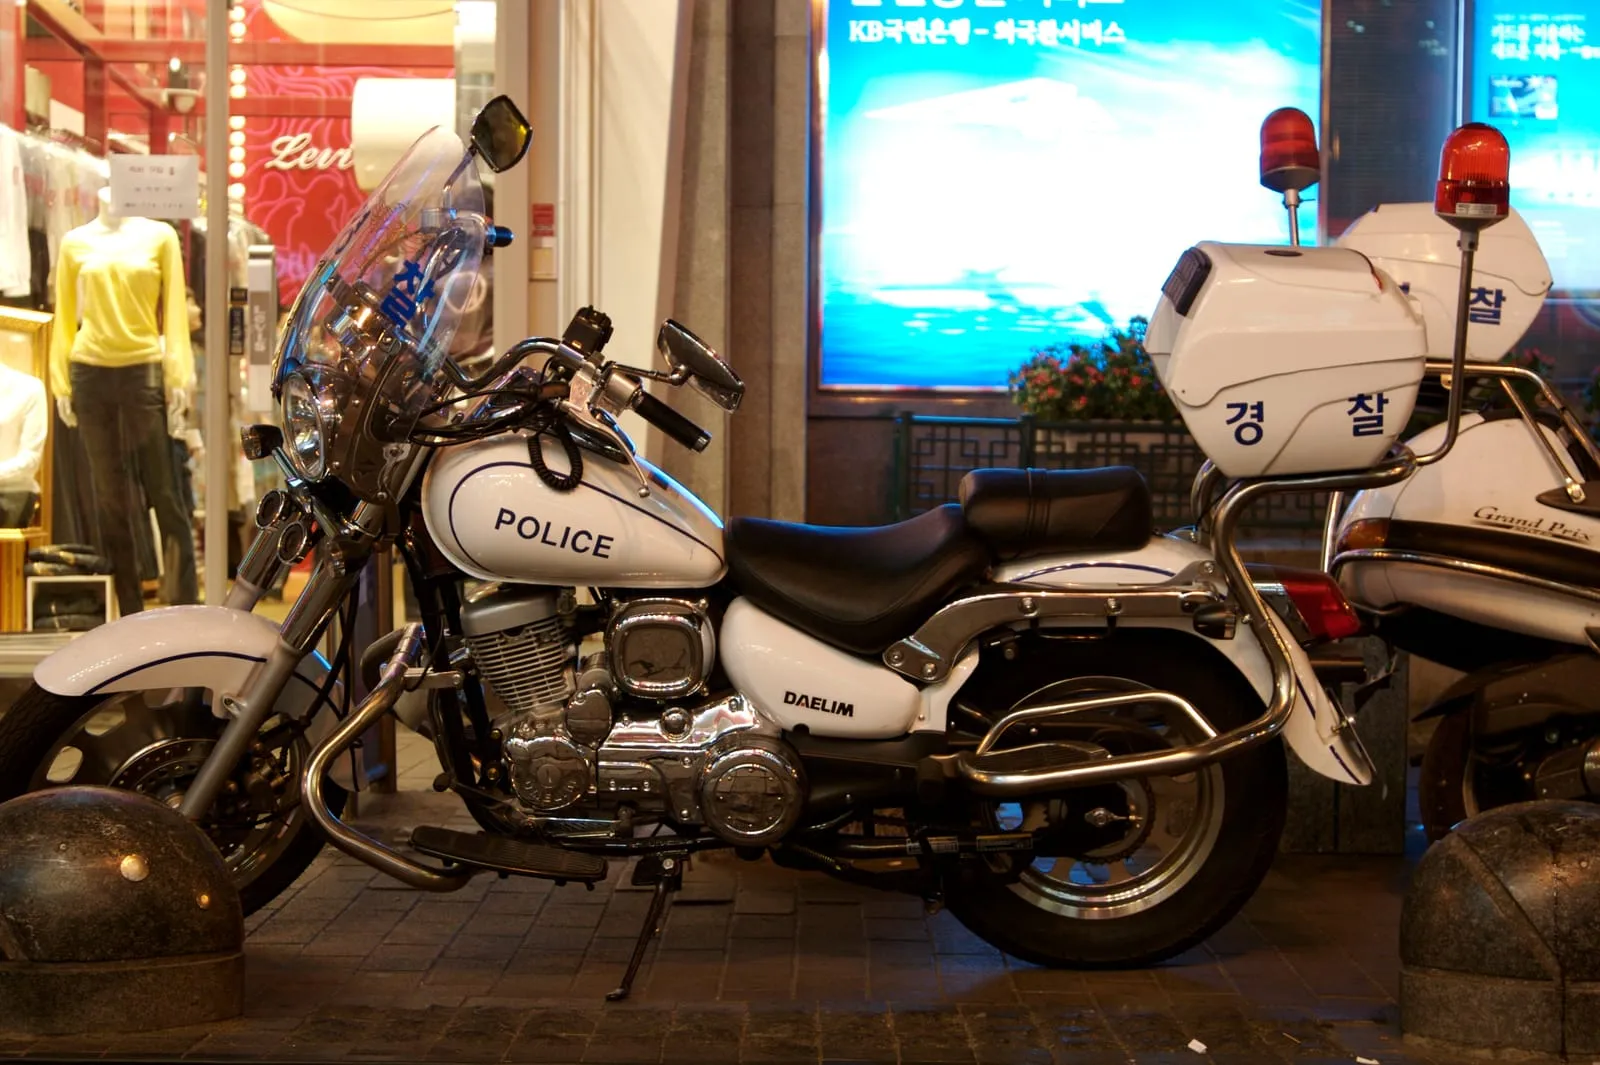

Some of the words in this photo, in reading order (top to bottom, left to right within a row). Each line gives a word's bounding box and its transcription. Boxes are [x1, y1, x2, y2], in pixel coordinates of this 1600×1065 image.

[1469, 286, 1506, 325] 찰
[1226, 401, 1264, 446] 경
[1347, 392, 1389, 437] 찰
[494, 507, 614, 559] POLICE
[1473, 505, 1544, 528] Grand
[783, 690, 855, 718] DAELIM
